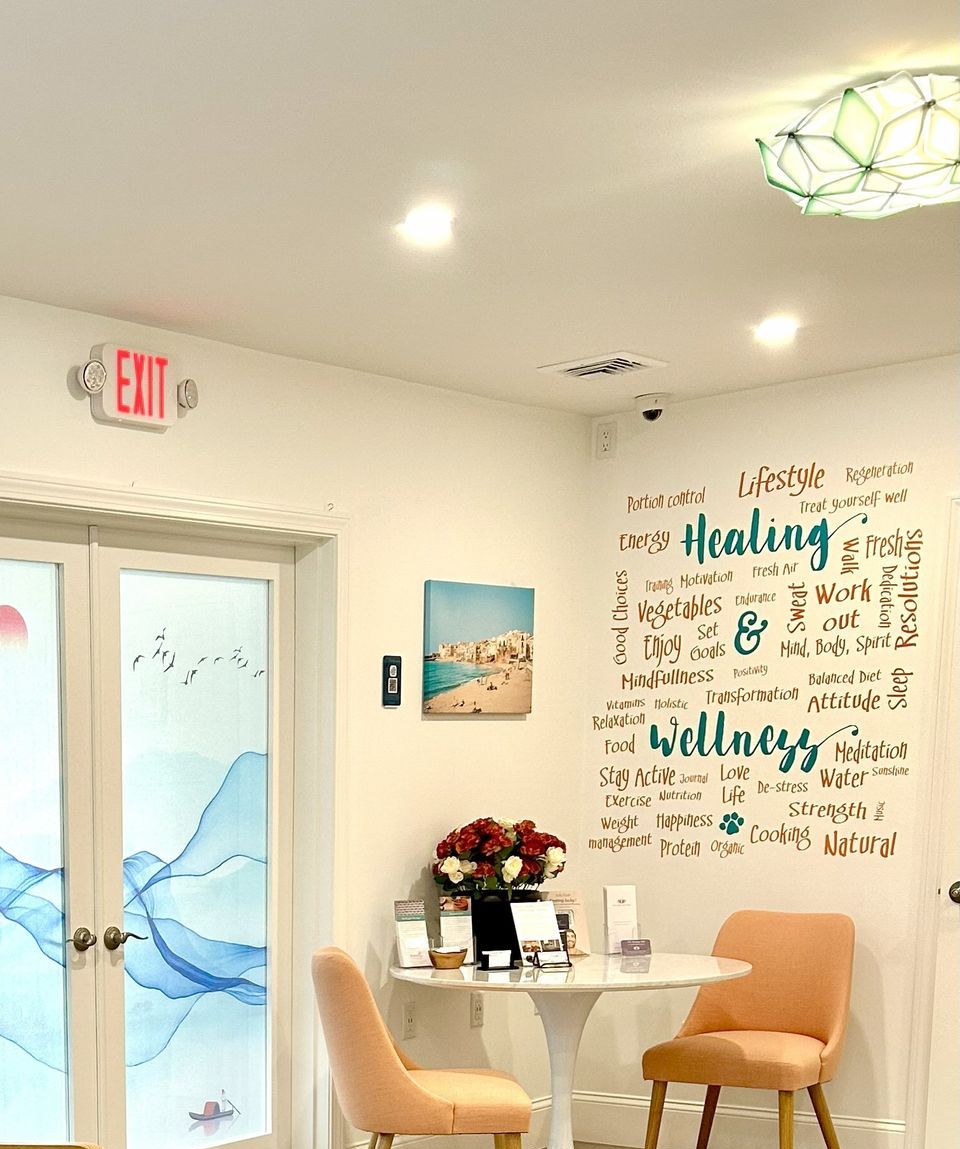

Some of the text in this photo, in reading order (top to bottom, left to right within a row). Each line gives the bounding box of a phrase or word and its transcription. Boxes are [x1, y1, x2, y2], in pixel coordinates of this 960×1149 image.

[116, 349, 168, 419] EXIT
[738, 462, 825, 498] Lifestyle
[846, 461, 914, 486] Regeneration
[627, 486, 706, 513] Portion control
[799, 488, 908, 514] Treat yourself well
[619, 530, 670, 555] Energy
[680, 507, 868, 571] Healing
[865, 527, 904, 559] Fresh
[840, 537, 860, 575] Walk
[680, 570, 733, 588] Motivation
[752, 562, 799, 578] Fresh Air
[735, 592, 777, 606] Endurance
[815, 578, 872, 605] Work
[878, 565, 898, 629] Dedication
[894, 528, 924, 650] Resolutions
[611, 569, 629, 666] Good Choices
[638, 593, 722, 629] Vegetables
[787, 581, 808, 634] Sweat
[697, 622, 719, 640] Set
[822, 609, 860, 631] out
[733, 611, 768, 655] &
[644, 634, 682, 668] Enjoy
[690, 641, 726, 661] Goals
[780, 632, 892, 658] Mind, Body, Spirit
[621, 668, 714, 690] Mindfullness
[808, 668, 882, 686] Balanced Diet
[887, 667, 914, 710] Sleep
[606, 698, 646, 711] Vitamins
[654, 698, 689, 710] Holistic
[705, 686, 799, 706] Transformation
[807, 689, 881, 713] Attitude
[592, 711, 646, 731] Relaxation
[605, 733, 635, 755] Food
[835, 738, 908, 764] Meditation
[599, 764, 676, 791] Stay Active
[679, 772, 709, 784] Journal
[720, 763, 750, 781] Love
[820, 767, 869, 789] Water
[659, 789, 702, 801] Nutrition
[722, 785, 746, 806] Life
[757, 780, 809, 794] De-stress
[605, 794, 652, 808] Exercise
[788, 800, 867, 824] Strength
[600, 814, 639, 834] Weight
[656, 812, 713, 832] Happiness
[588, 833, 652, 853] management
[660, 838, 701, 858] Protein
[750, 822, 811, 851] Cooking
[824, 830, 897, 858] Natural
[710, 839, 745, 858] Organic
